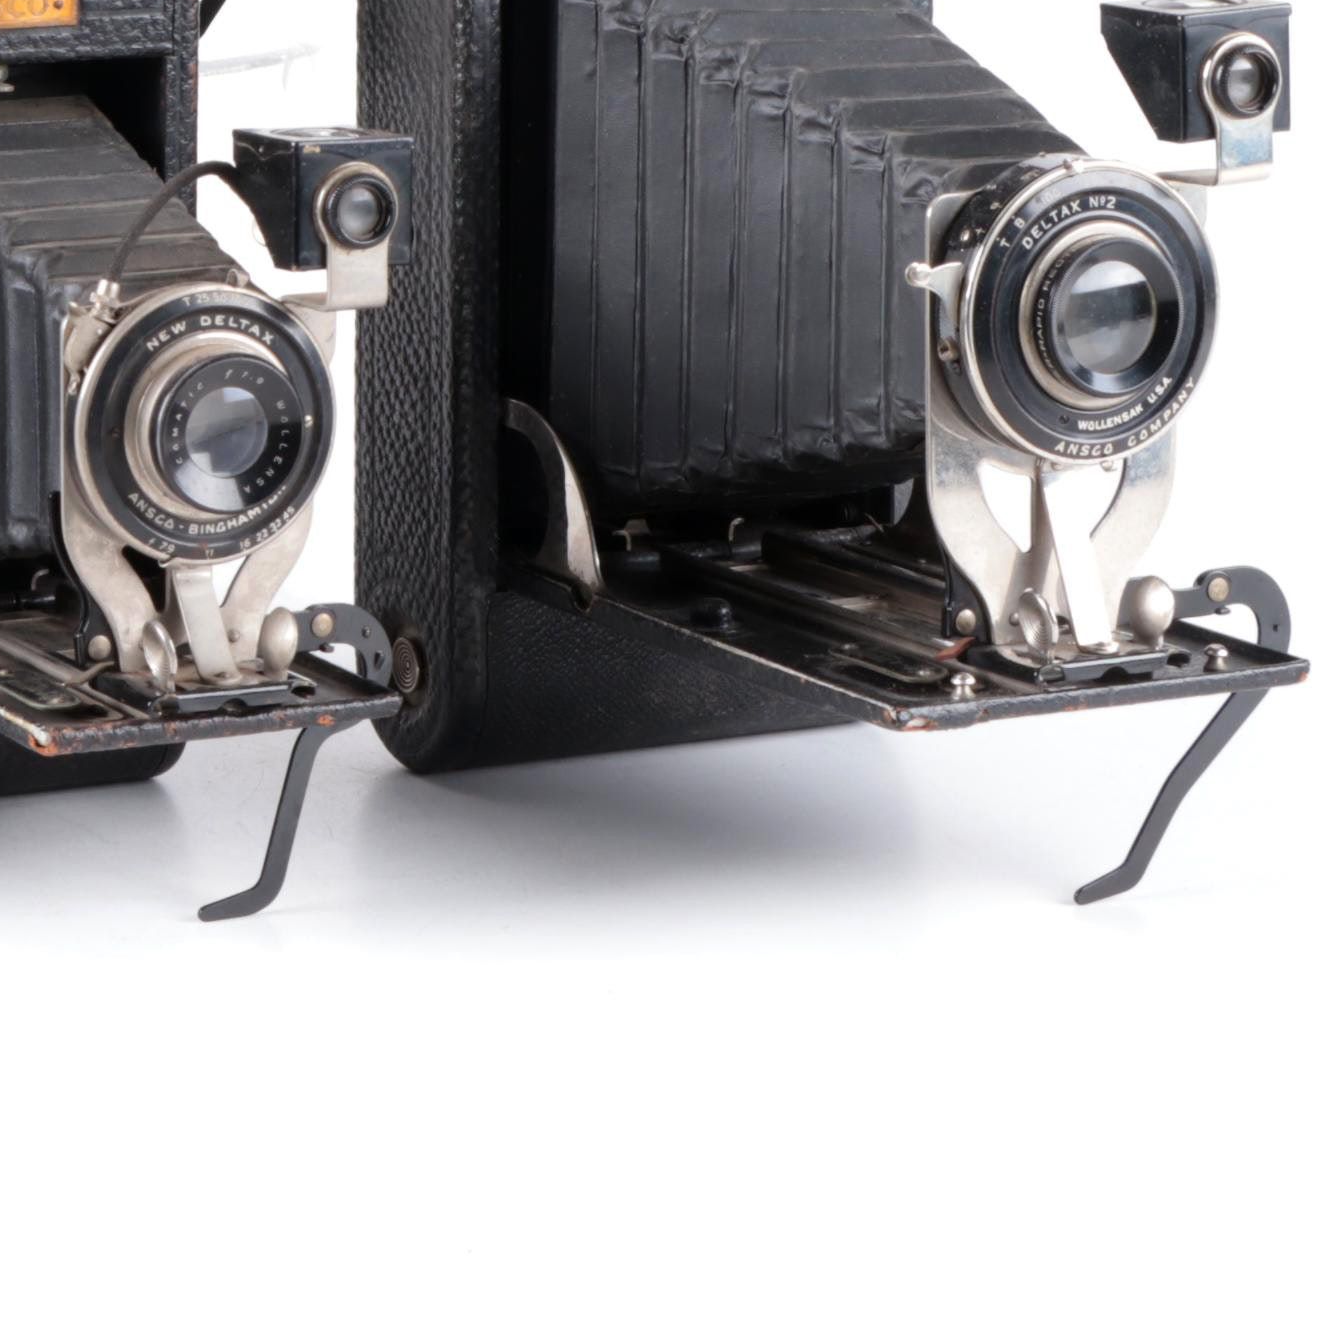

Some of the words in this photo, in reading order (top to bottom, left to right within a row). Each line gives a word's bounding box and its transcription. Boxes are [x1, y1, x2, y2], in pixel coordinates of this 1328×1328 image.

[1000, 238, 1010, 249] T
[1014, 217, 1025, 229] B
[1022, 199, 1082, 250] DELTAX
[146, 321, 187, 351] NEW
[200, 314, 275, 345] DELTAX
[1055, 441, 1114, 457] ANSCO
[1127, 377, 1195, 447] COMPANY
[1077, 403, 1144, 431] WOLLENSAK
[128, 492, 175, 529] ANSCO
[188, 485, 287, 535] BINGHAM
